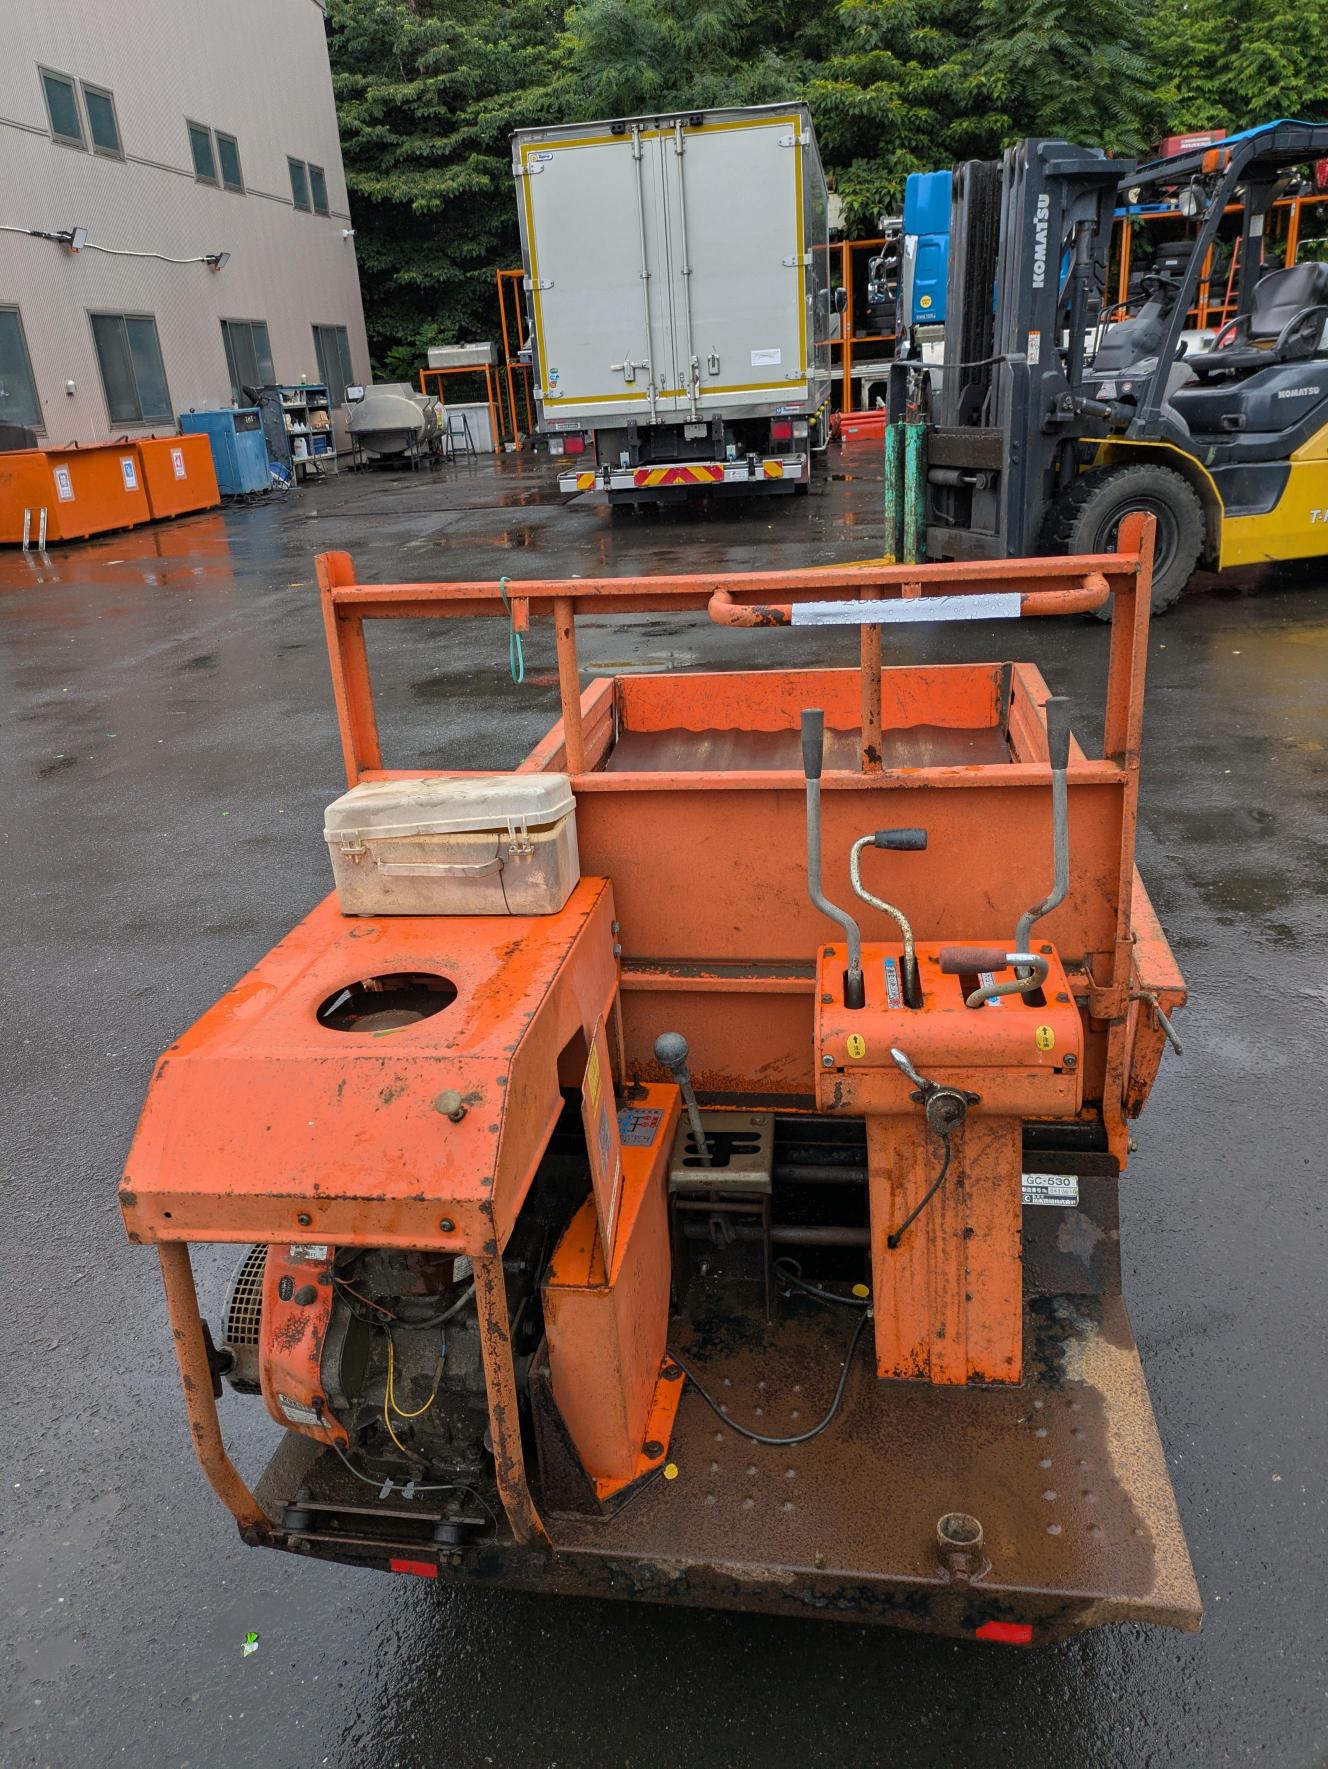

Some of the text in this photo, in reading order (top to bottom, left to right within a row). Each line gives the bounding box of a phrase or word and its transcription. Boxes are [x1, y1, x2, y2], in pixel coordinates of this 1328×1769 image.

[1032, 194, 1050, 288] KOMATSU
[1278, 386, 1320, 399] KOMATSU
[1026, 1176, 1071, 1187] GC-530
